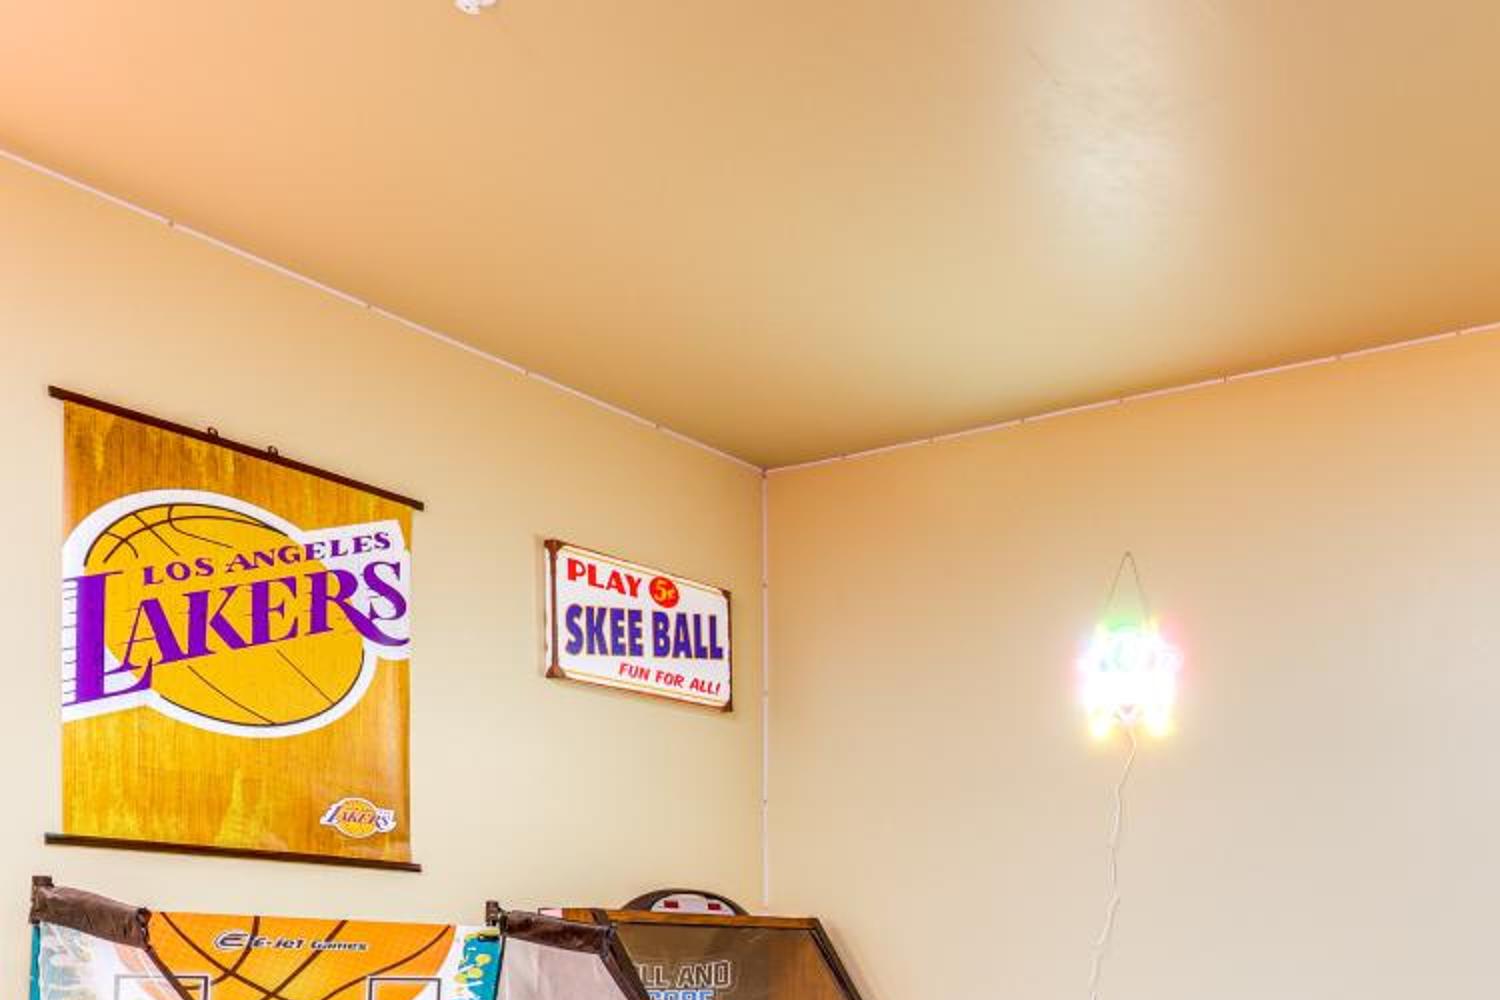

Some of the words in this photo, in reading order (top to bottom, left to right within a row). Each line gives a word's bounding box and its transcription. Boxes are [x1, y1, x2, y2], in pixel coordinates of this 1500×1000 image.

[142, 555, 215, 587] LOS
[224, 530, 392, 574] ANGELES
[567, 557, 642, 598] PLAY
[62, 560, 411, 707] LAKERS
[565, 603, 644, 657] SKEE
[652, 610, 723, 660] BALL
[619, 662, 649, 681] FUN
[655, 670, 684, 688] FOR
[689, 678, 721, 695] ALL!
[677, 961, 732, 989] AND
